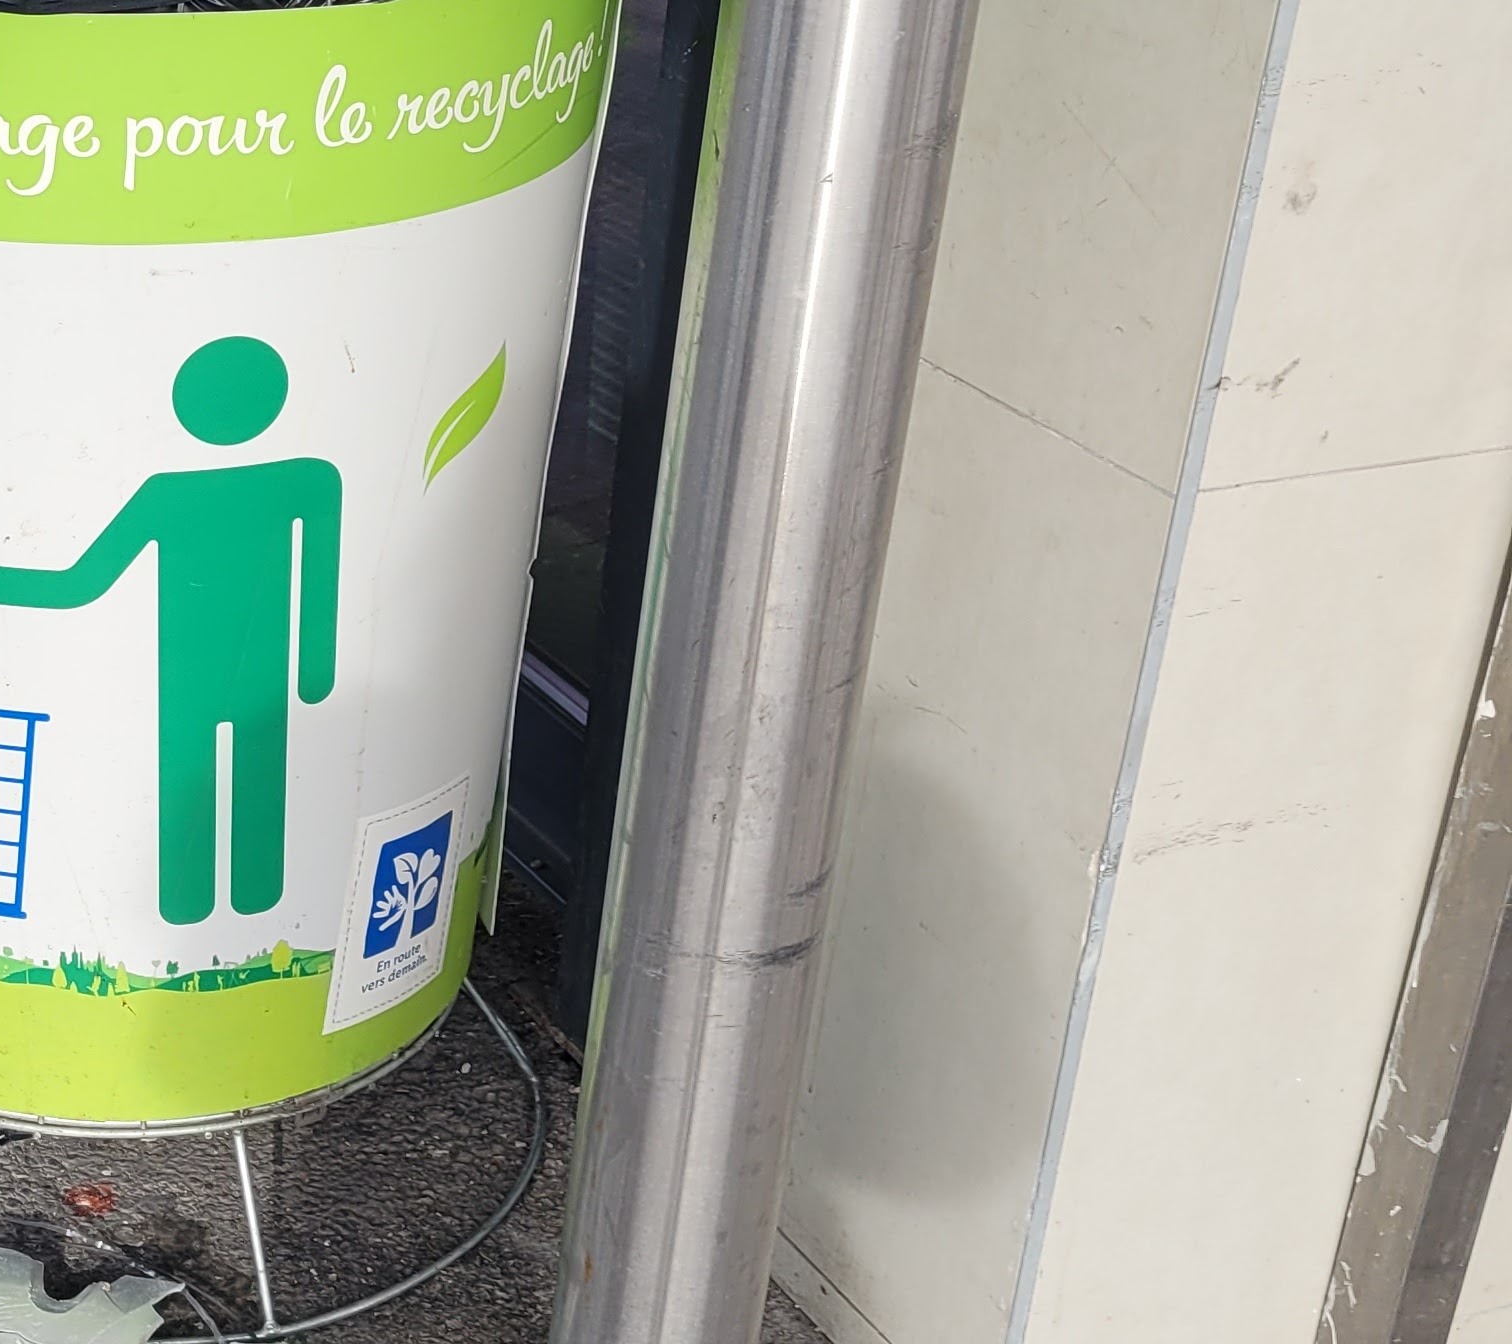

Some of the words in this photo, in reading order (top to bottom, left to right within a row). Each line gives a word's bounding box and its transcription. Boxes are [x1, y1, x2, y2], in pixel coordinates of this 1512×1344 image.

[123, 109, 294, 191] pour
[315, 64, 373, 147] le
[377, 959, 391, 974] En
[393, 943, 422, 967] route
[361, 976, 386, 994] vers
